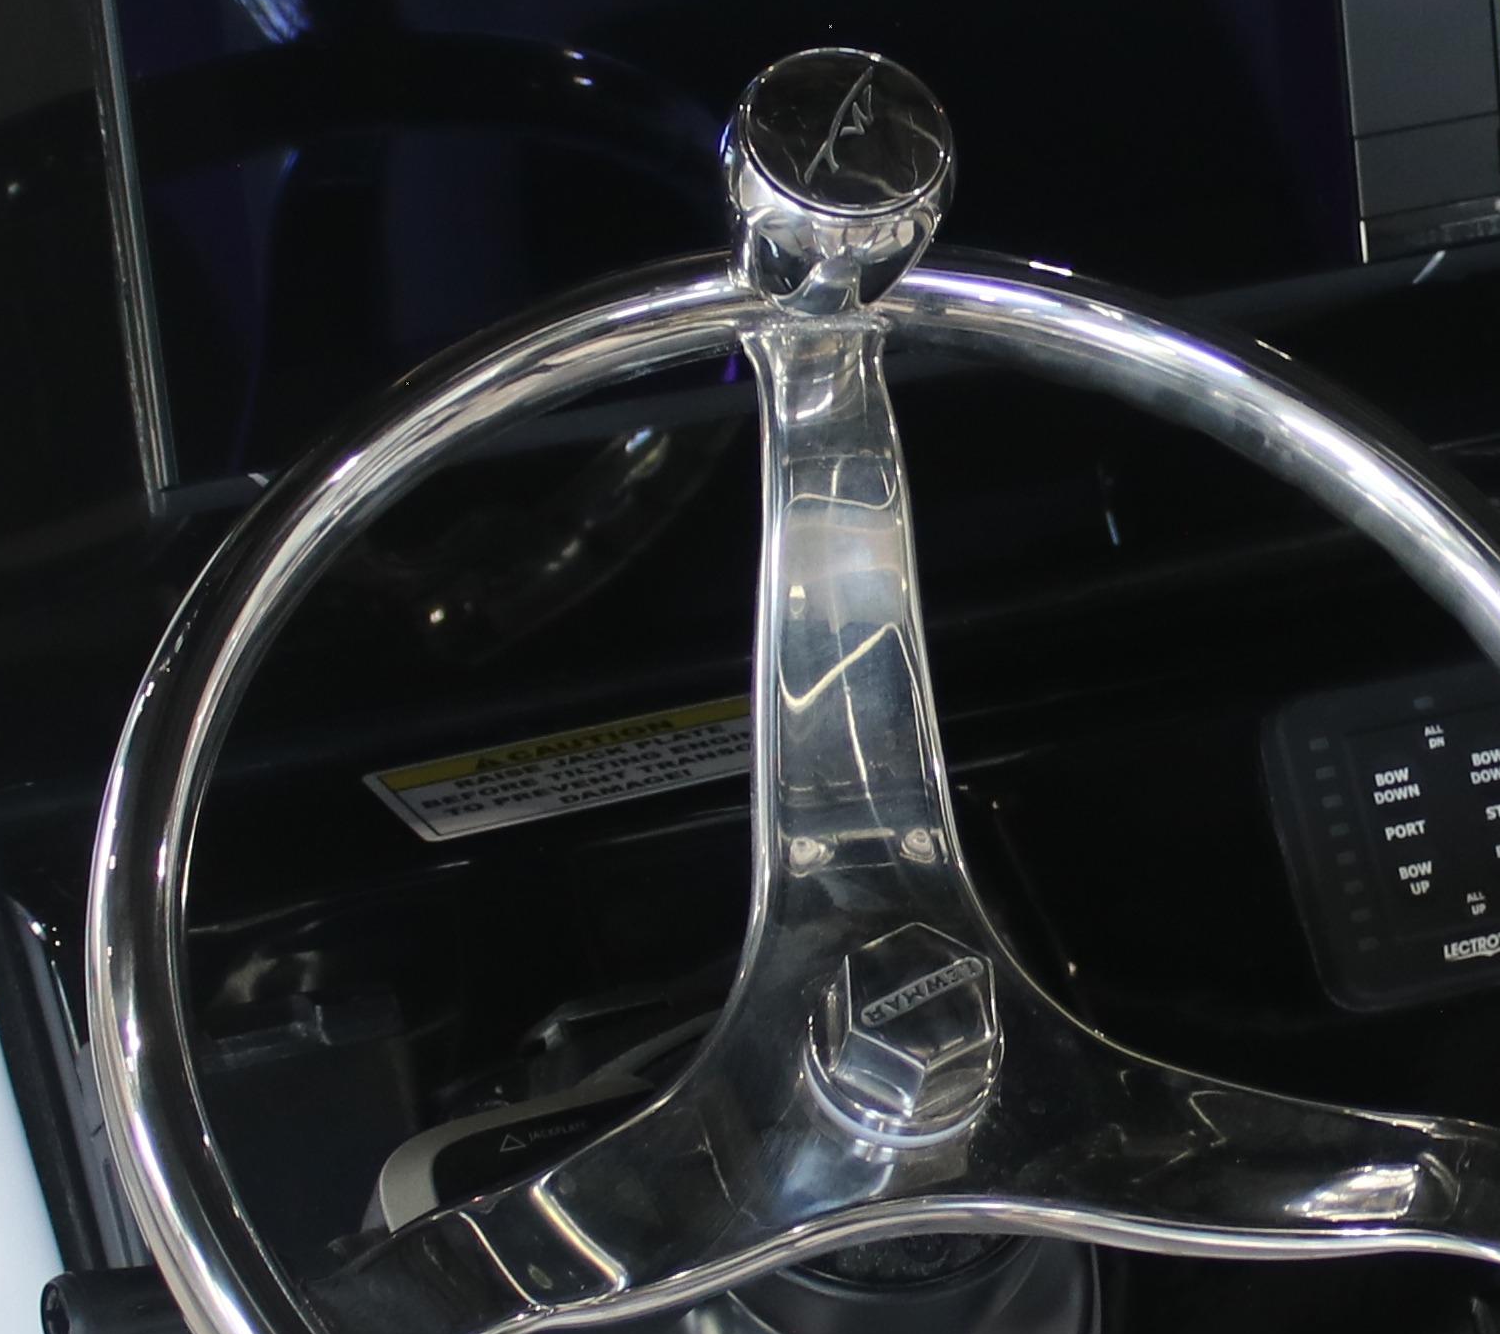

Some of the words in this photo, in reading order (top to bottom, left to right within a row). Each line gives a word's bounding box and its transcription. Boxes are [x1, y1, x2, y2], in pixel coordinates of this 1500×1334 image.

[506, 720, 675, 761] CAUTION
[1424, 724, 1444, 736] ALL
[550, 746, 627, 767] JACK
[634, 725, 725, 748] PLATE
[420, 778, 539, 808] BEFORE
[546, 751, 662, 780] TILTING
[669, 731, 751, 753] ENGIN
[1375, 768, 1410, 787] BOW
[444, 803, 485, 816] TO
[493, 771, 628, 805] PREVENT
[1373, 784, 1421, 805] DOWN
[1384, 820, 1427, 841] PORT
[1398, 861, 1433, 880] BOW
[1410, 880, 1431, 896] UP
[1466, 891, 1486, 903] ALL
[1471, 903, 1487, 916] UP
[865, 959, 978, 1023] LEWMAR
